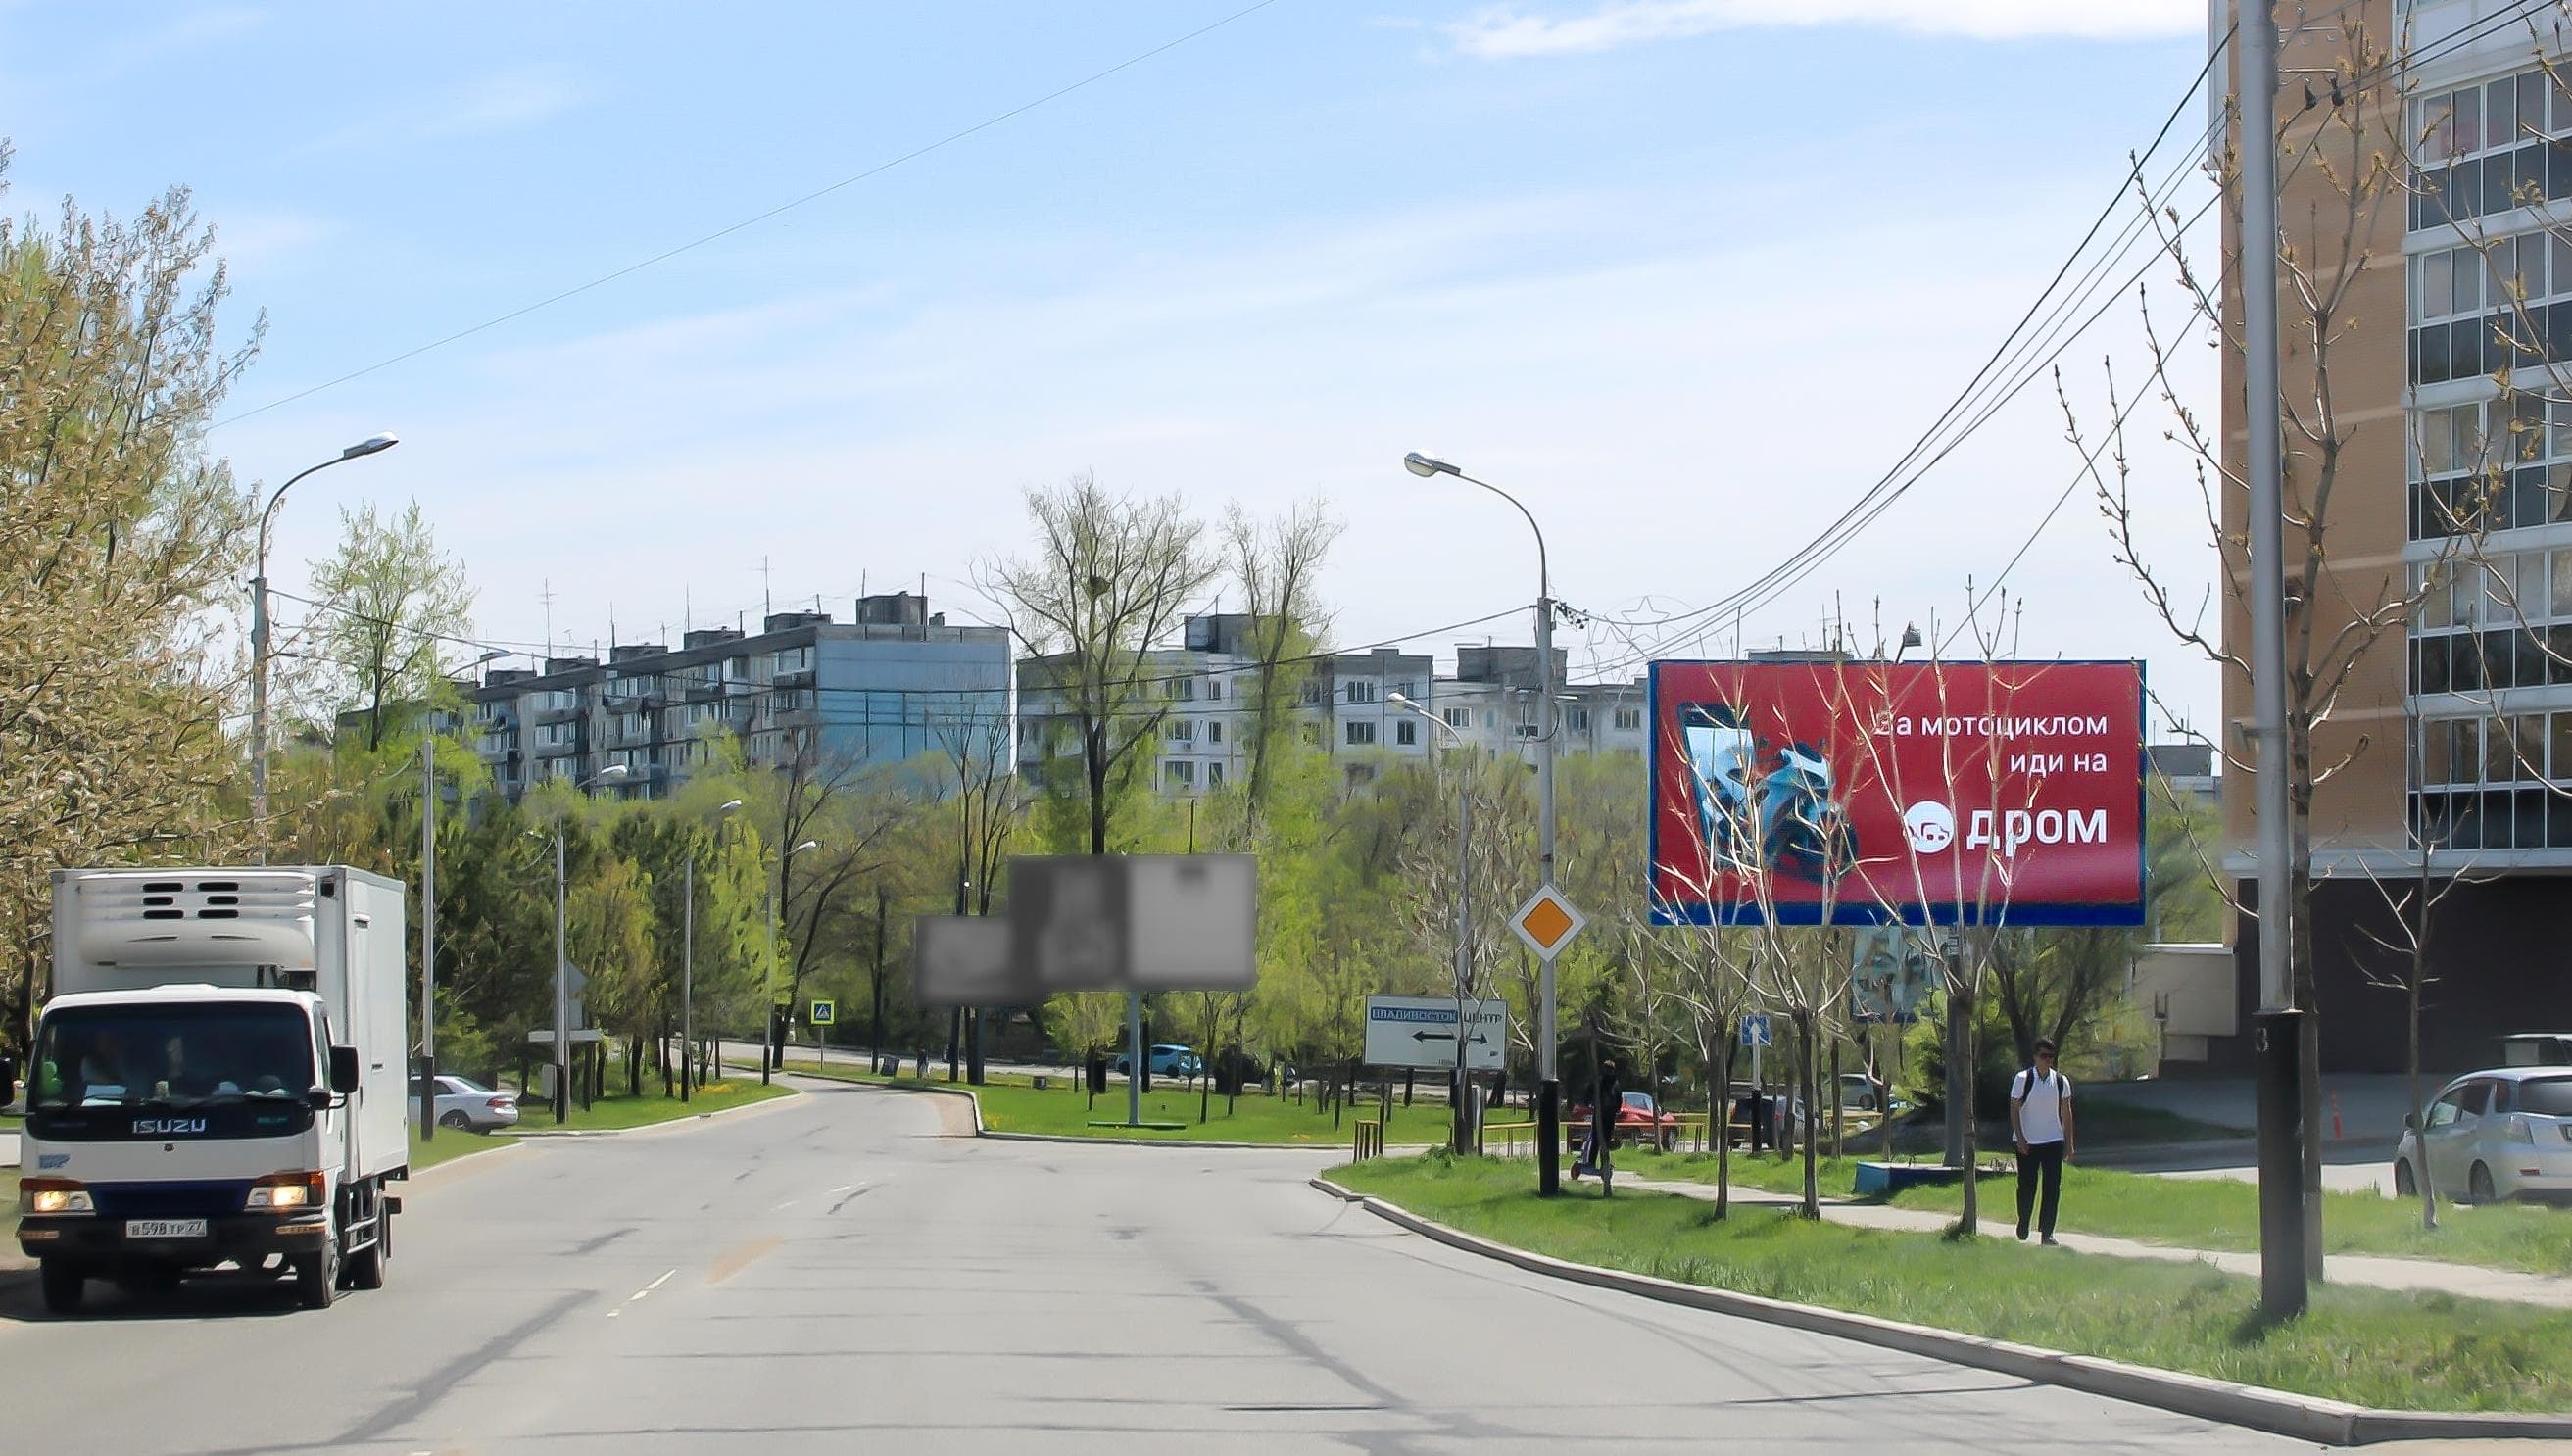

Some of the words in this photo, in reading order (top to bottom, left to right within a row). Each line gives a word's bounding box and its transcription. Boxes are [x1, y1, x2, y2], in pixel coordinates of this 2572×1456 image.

[1921, 716, 2107, 740] мотоциклом
[2010, 753, 2063, 778] иди
[2074, 753, 2107, 772] на
[133, 1119, 206, 1134] ISUZU
